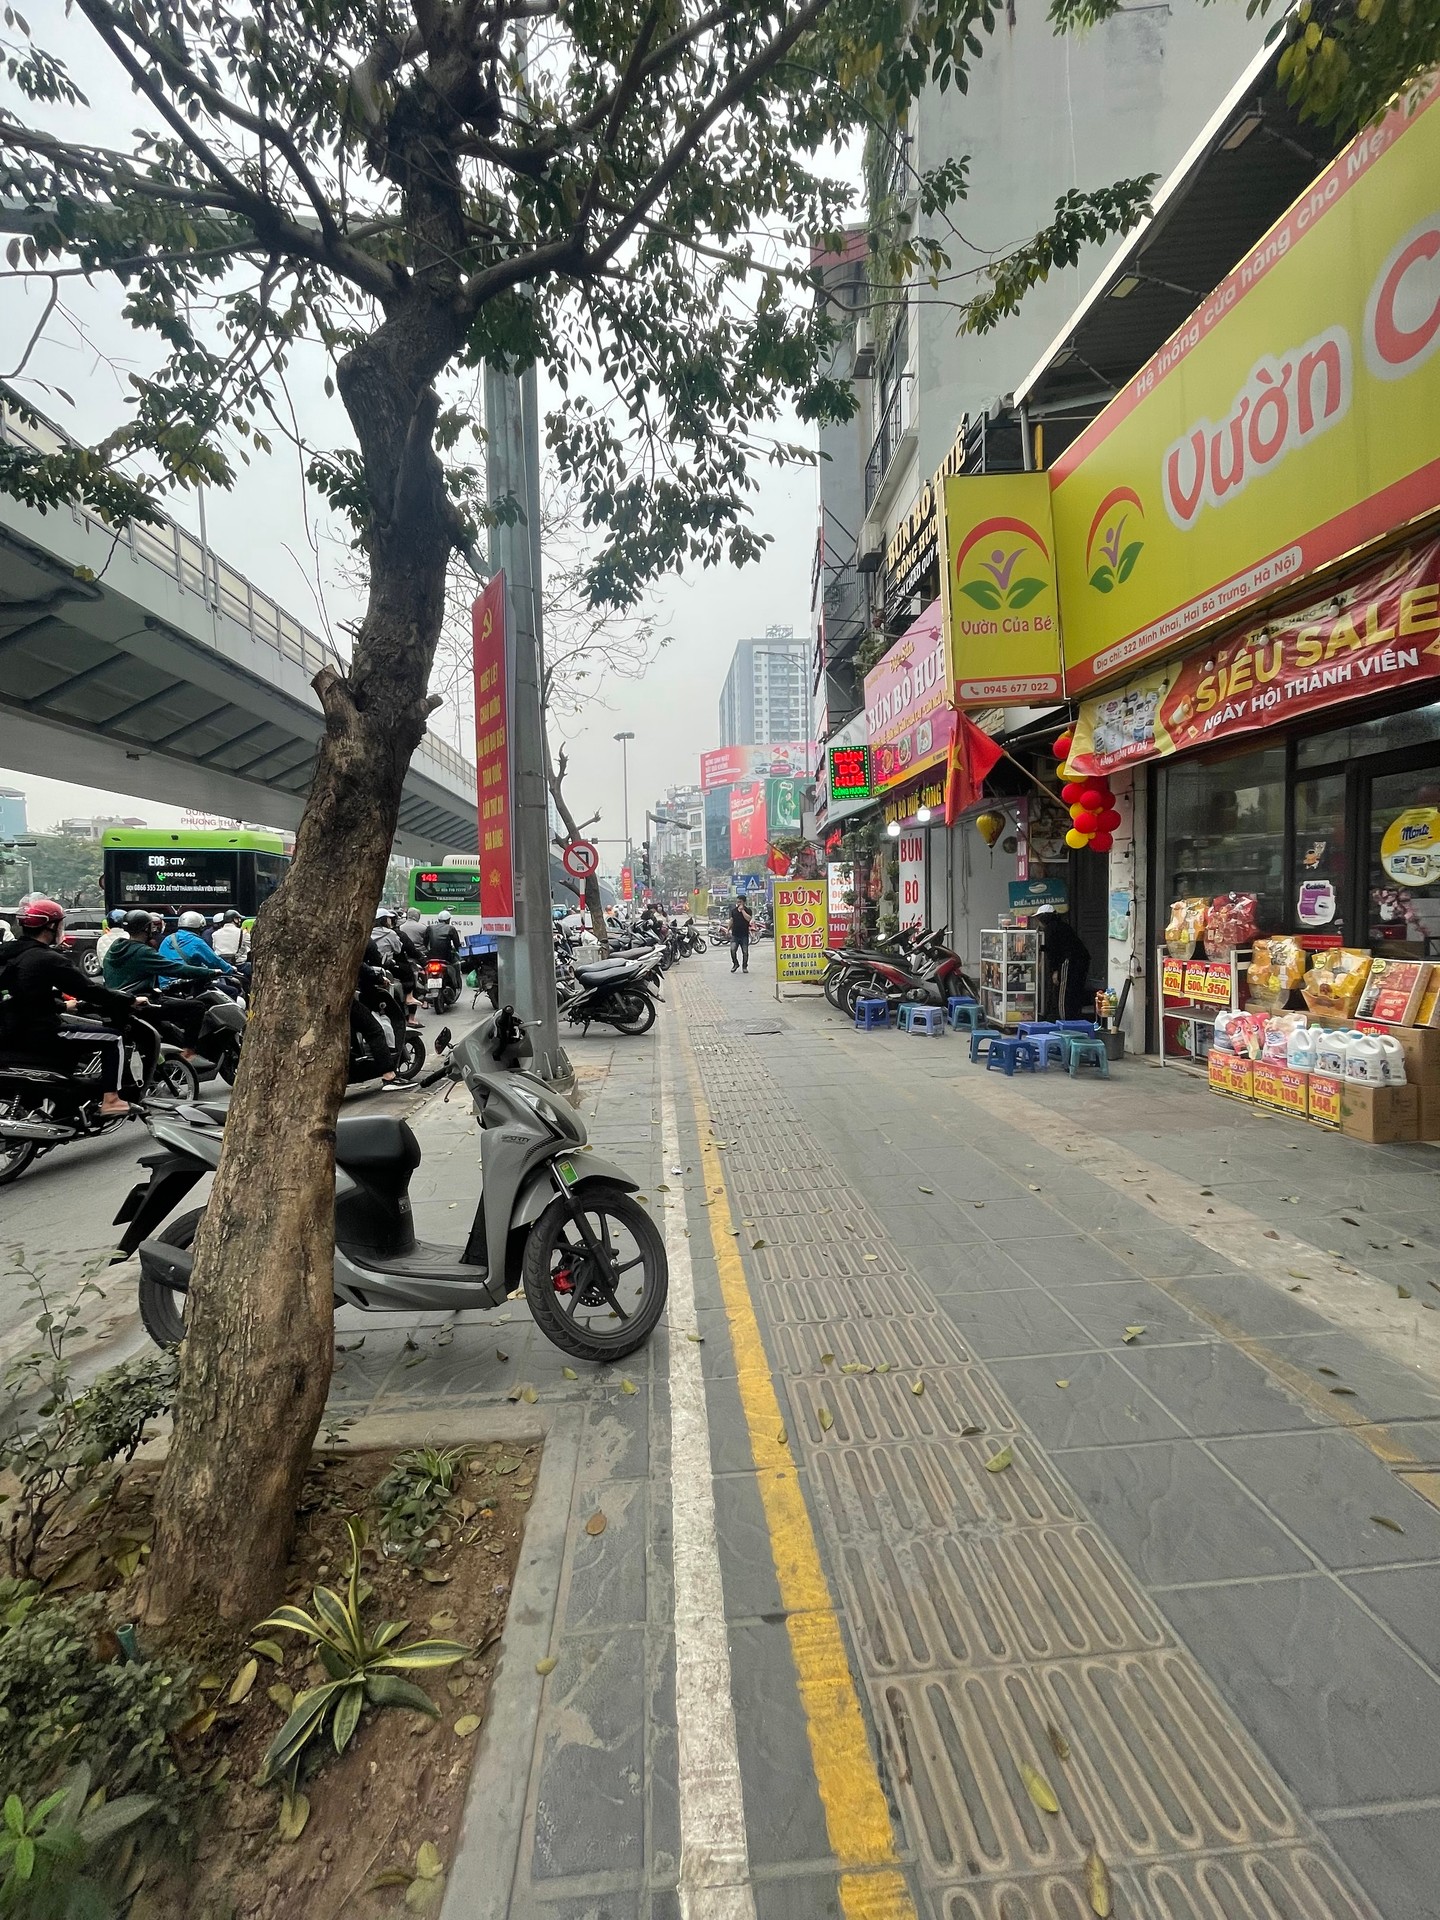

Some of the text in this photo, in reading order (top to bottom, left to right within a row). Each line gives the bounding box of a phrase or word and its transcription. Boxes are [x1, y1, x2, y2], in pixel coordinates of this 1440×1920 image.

[1136, 368, 1154, 398] Hệ
[1157, 323, 1200, 375] thống
[1203, 287, 1237, 327] cửa
[1240, 227, 1292, 289] hàng
[1297, 176, 1340, 229] cho
[1167, 340, 1342, 521] Vườn
[888, 522, 912, 572] BÚN
[912, 479, 932, 536] BÒ
[961, 616, 1052, 636] Vườn Của Bé
[1096, 655, 1108, 670] Địa
[1123, 640, 1137, 656] 322
[1138, 630, 1158, 648] Minh
[1160, 618, 1182, 636] Khai,
[1184, 607, 1200, 624] Hai
[1202, 598, 1215, 614] Bà
[1218, 582, 1251, 605] Trưng,
[1254, 568, 1270, 587] Hà
[1274, 553, 1296, 574] Nội
[1196, 640, 1283, 713] SIÊU
[1295, 583, 1440, 668] SALE
[868, 693, 892, 736] BÚN
[893, 668, 912, 714] BÒ
[984, 682, 1048, 694] 0945 677 022
[1202, 647, 1419, 733] NGÀY HỘI THÀNH VIÊN
[834, 750, 864, 764] BÚN
[839, 762, 860, 775] BÒ
[170, 858, 186, 866] CITY
[900, 833, 922, 862] BÚN
[779, 886, 822, 906] BÚN
[905, 874, 919, 904] BÒ
[788, 909, 815, 928] BÒ
[781, 927, 824, 950] HUẾ
